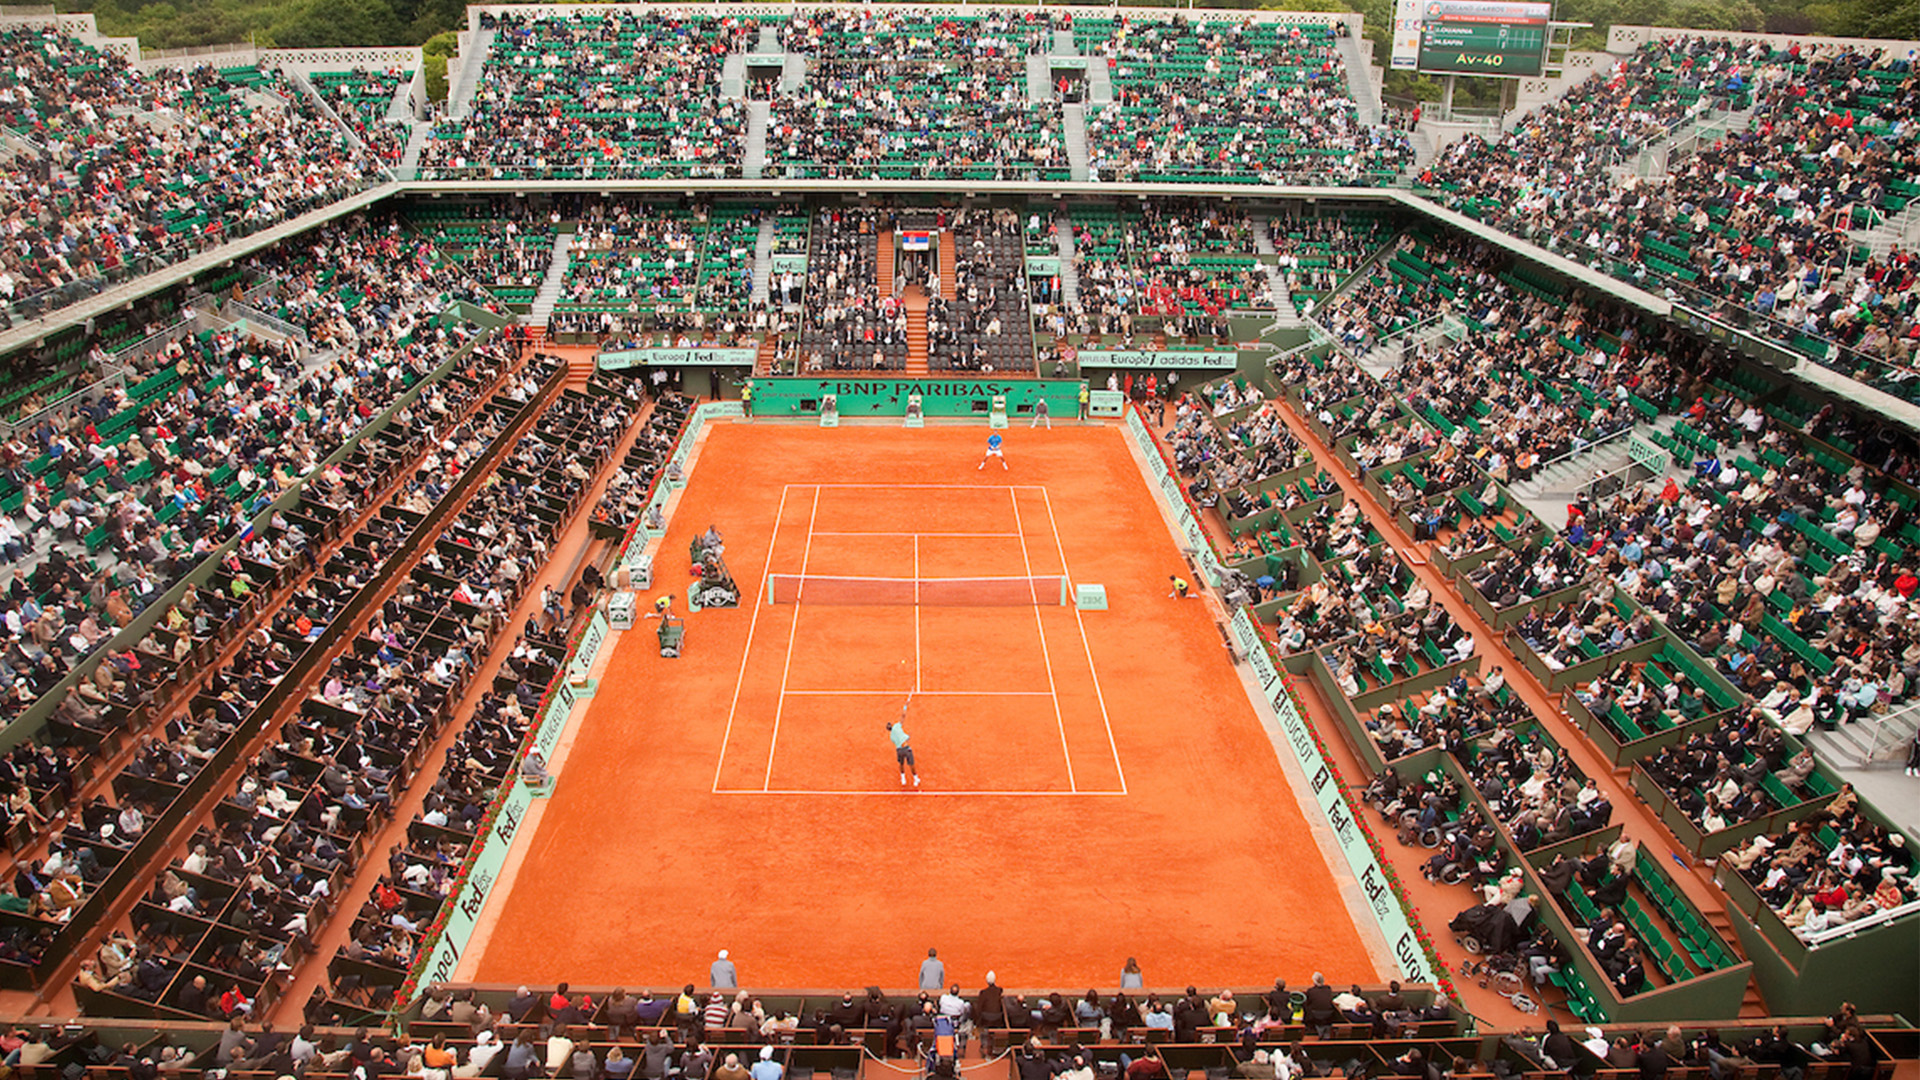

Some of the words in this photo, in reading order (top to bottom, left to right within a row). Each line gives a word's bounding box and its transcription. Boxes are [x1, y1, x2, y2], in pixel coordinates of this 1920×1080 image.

[1456, 53, 1503, 66] Av-40
[1160, 355, 1200, 365] adidas
[836, 383, 887, 395] BNP
[895, 383, 1000, 396] PARIBAS
[1082, 596, 1102, 605] IBM
[540, 702, 566, 752] PEUGEOT
[1281, 705, 1314, 763] PEUGEOT
[497, 800, 524, 846] FedEx
[1327, 798, 1354, 850] FedEx
[460, 868, 493, 922] FedEx
[1361, 863, 1390, 921] FedEx
